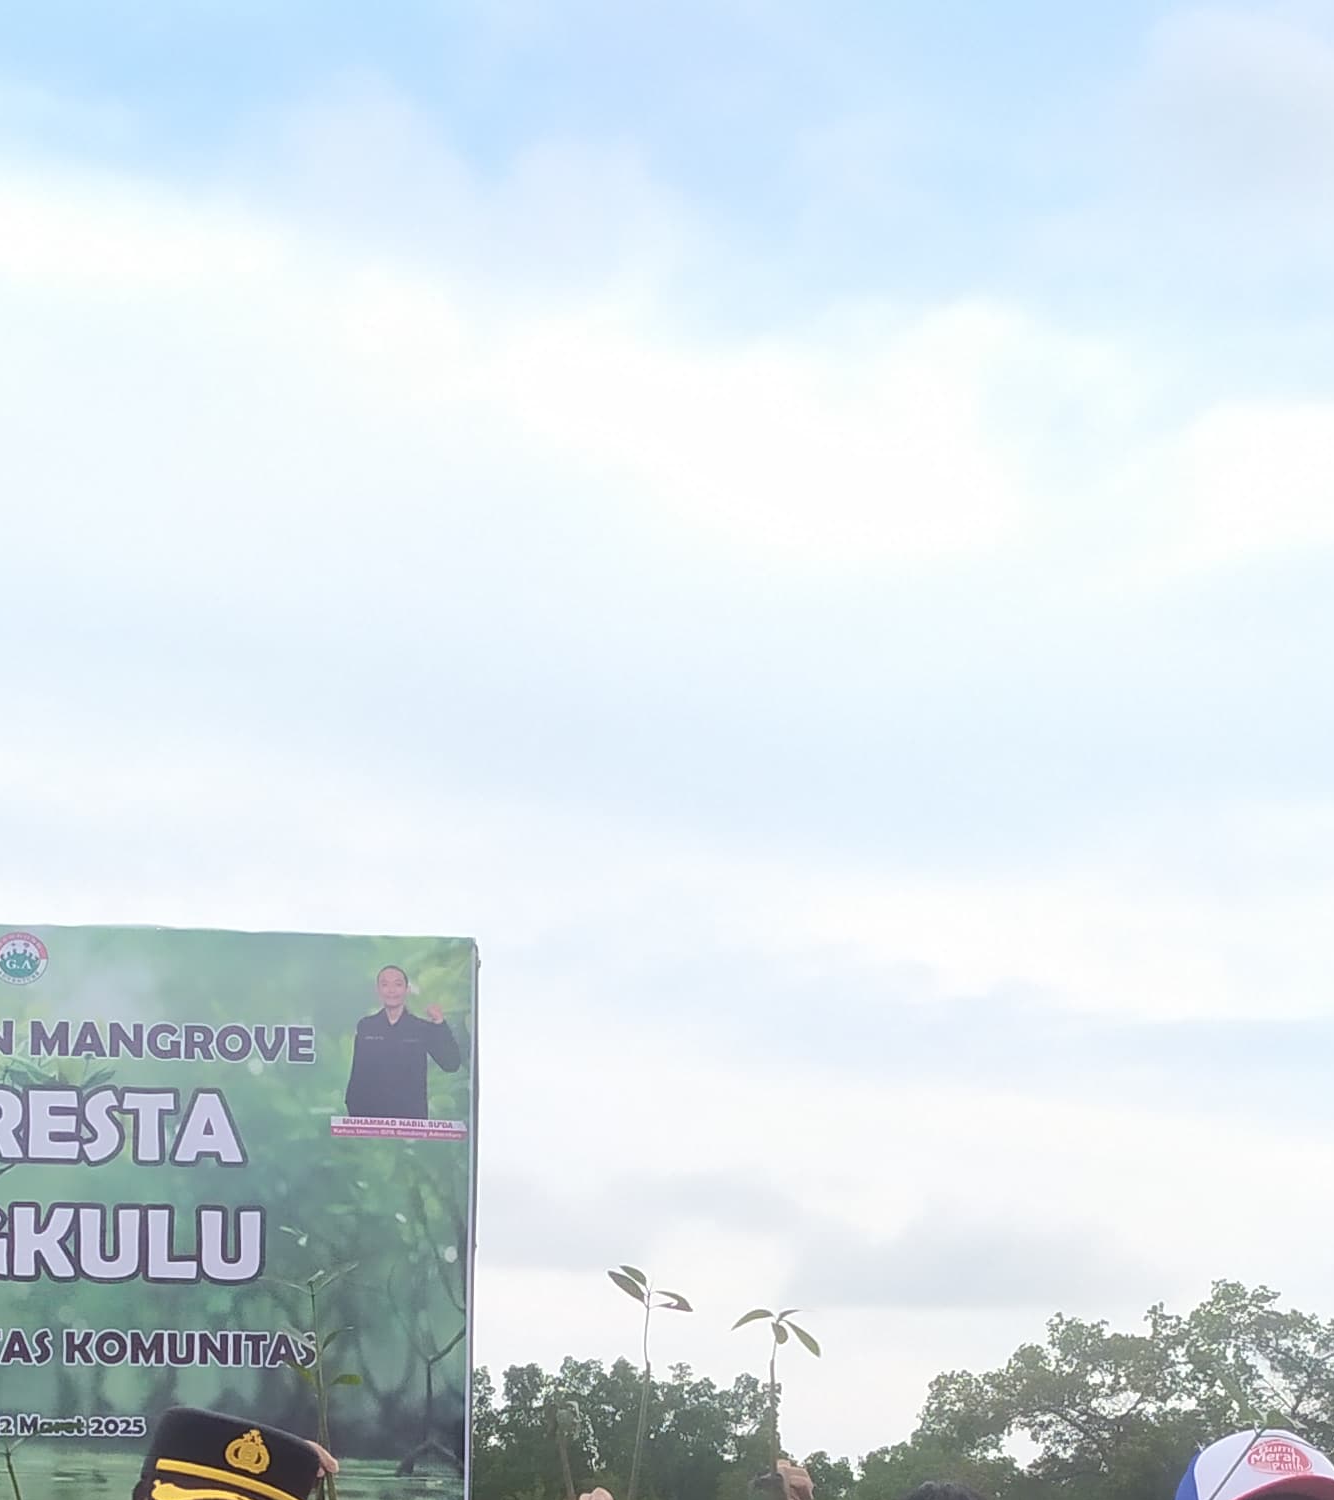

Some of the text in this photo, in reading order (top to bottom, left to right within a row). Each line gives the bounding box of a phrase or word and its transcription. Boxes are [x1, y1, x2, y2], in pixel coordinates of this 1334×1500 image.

[29, 1019, 316, 1064] MANGROVE
[63, 1329, 317, 1368] KOMUNITAS
[18, 1413, 86, 1437] Maret
[89, 1416, 147, 1437] 2025
[1250, 1448, 1301, 1464] Merah
